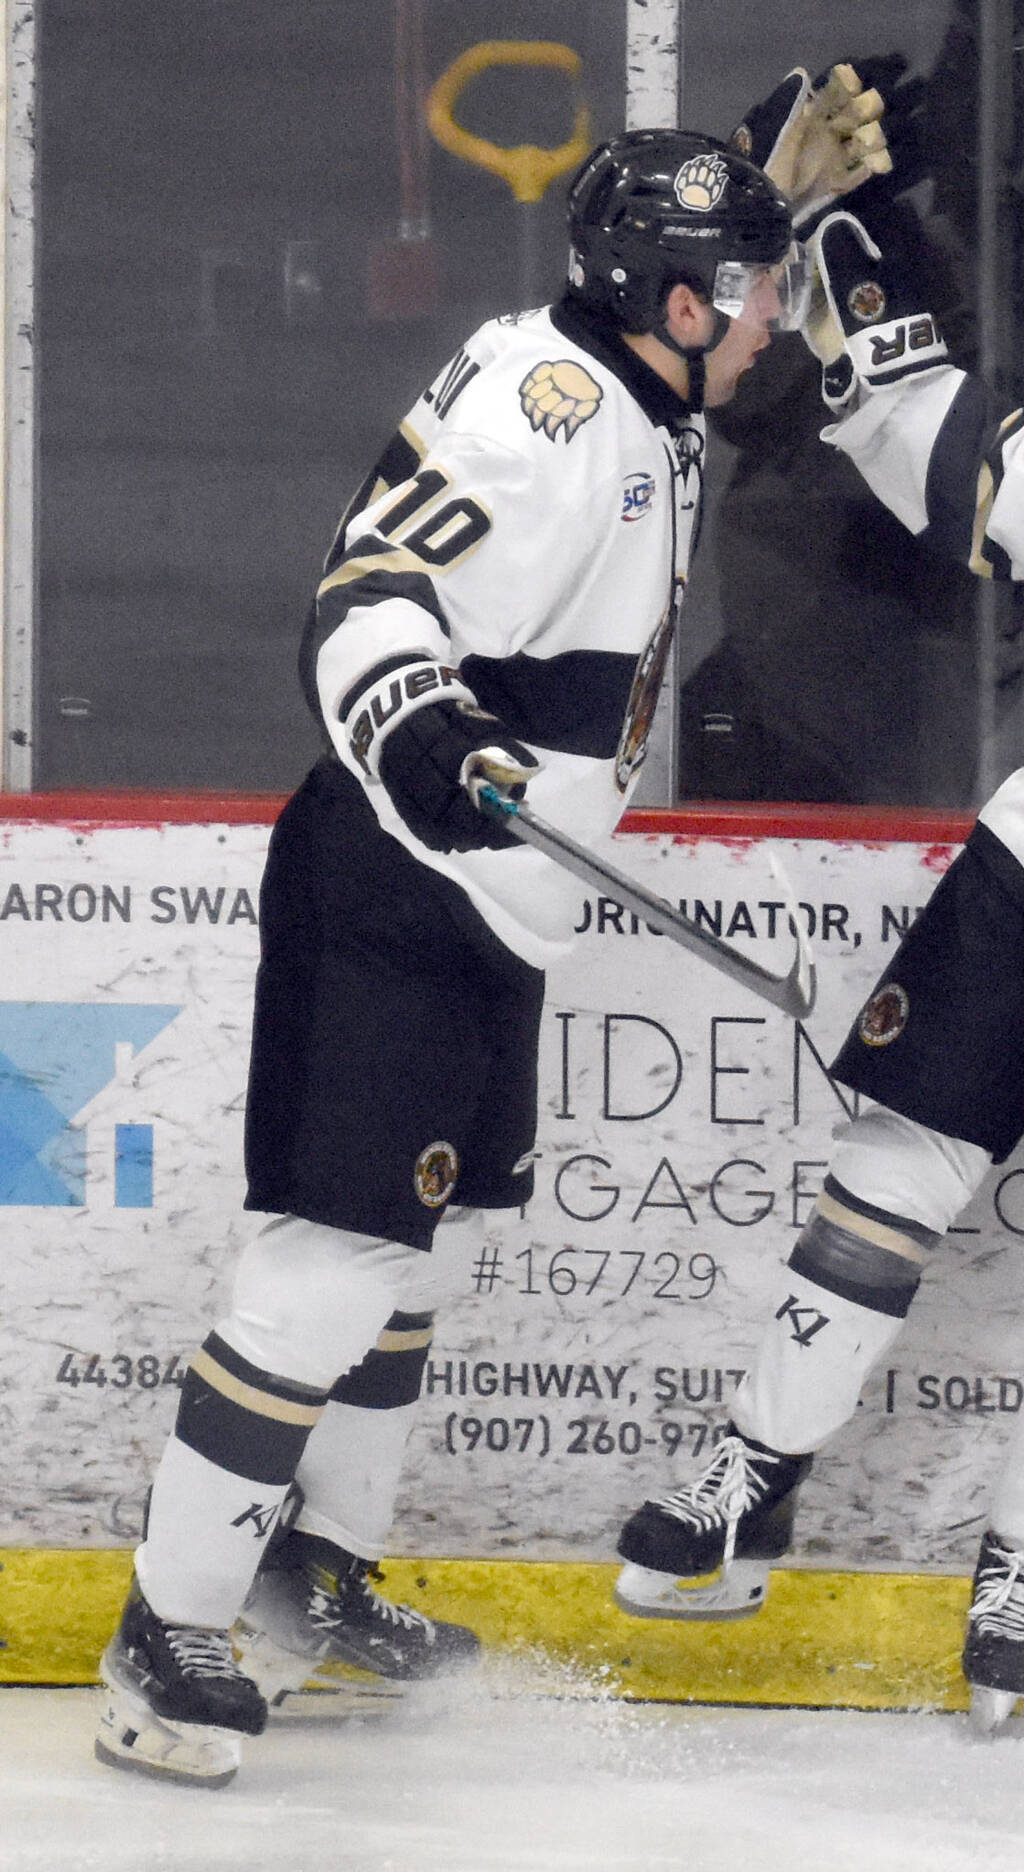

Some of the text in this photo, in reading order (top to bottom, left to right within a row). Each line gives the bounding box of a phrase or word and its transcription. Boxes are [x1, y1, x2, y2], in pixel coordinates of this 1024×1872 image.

[372, 464, 494, 571] 10
[471, 1246, 717, 1300] #167729
[426, 1359, 639, 1406] HIGHWAY,
[654, 1366, 751, 1403] SUIT
[445, 1411, 550, 1456] (907)
